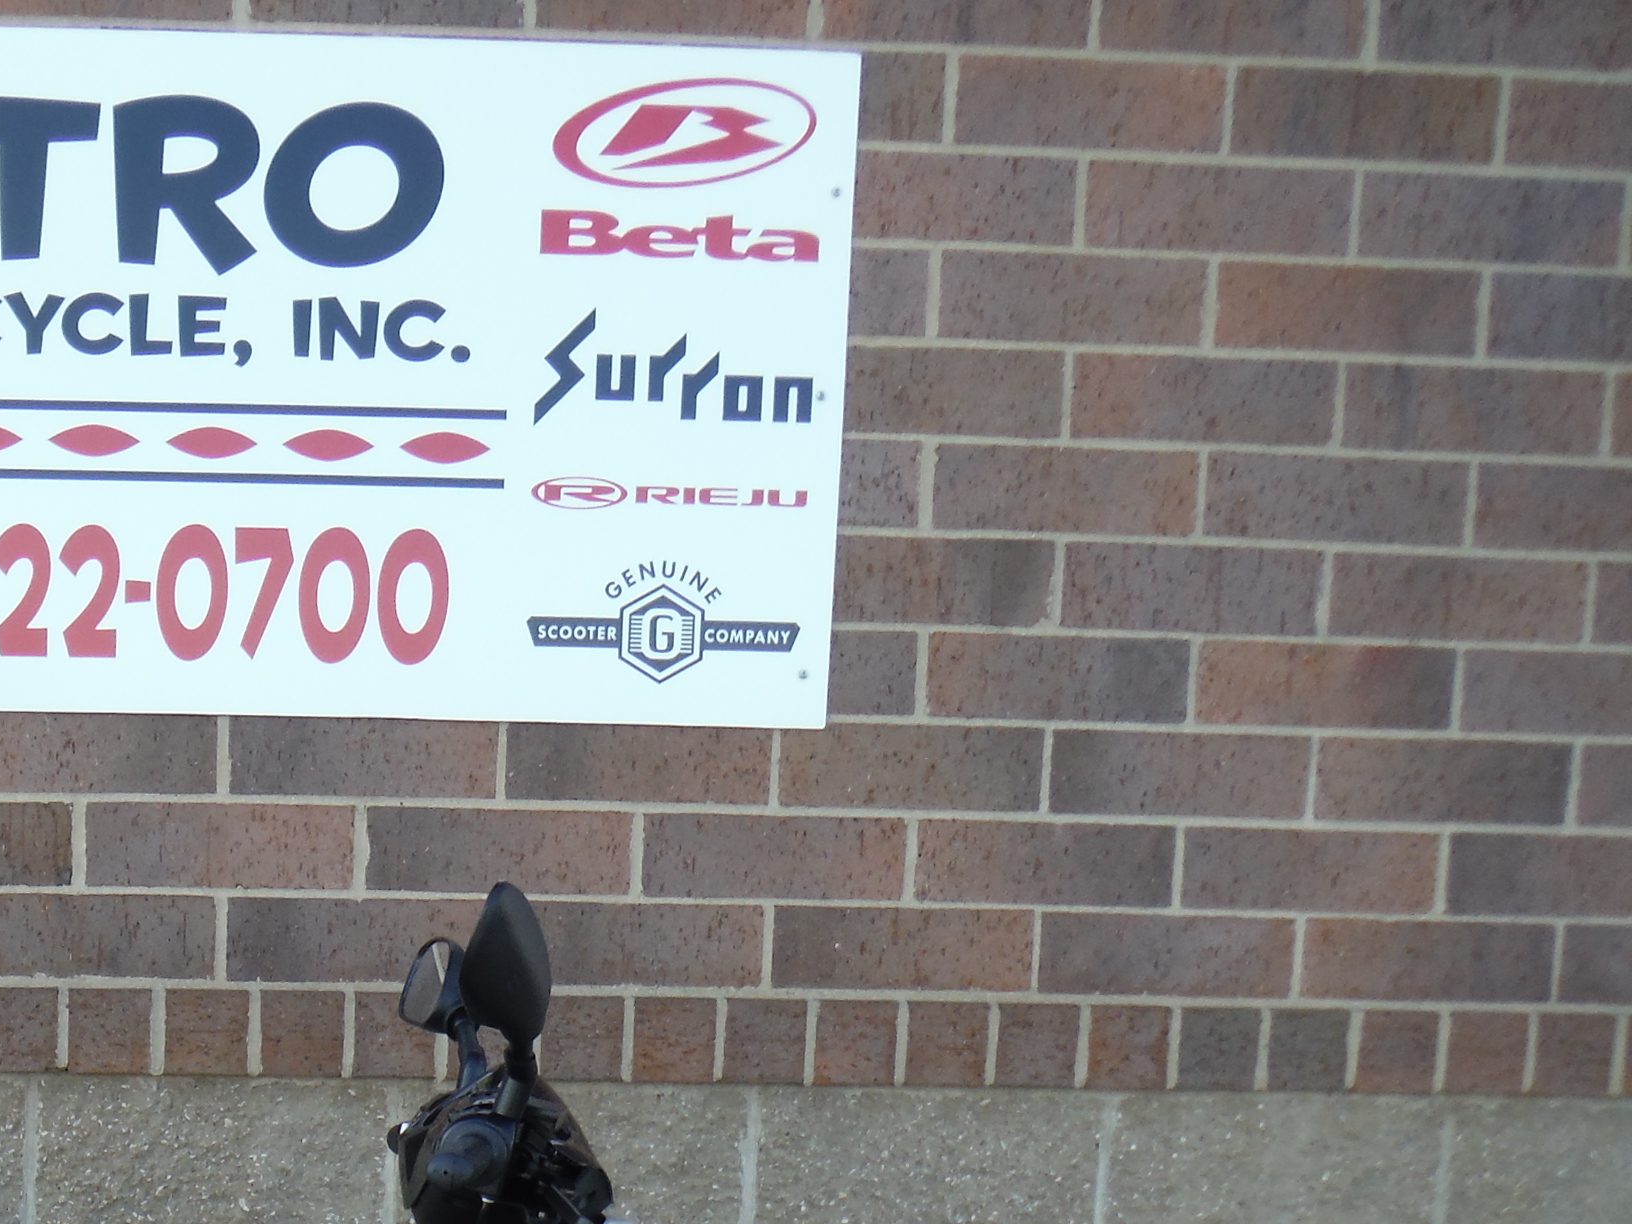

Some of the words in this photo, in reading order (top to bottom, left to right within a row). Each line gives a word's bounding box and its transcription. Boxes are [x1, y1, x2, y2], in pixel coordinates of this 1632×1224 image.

[540, 209, 820, 262] Beta
[293, 296, 470, 362] INC.
[533, 307, 814, 426] Surron
[635, 486, 808, 507] RIEJU
[605, 560, 722, 604] GENUINE
[537, 624, 617, 641] SCOOTER
[648, 614, 676, 654] G
[704, 628, 791, 645] COMPANY
